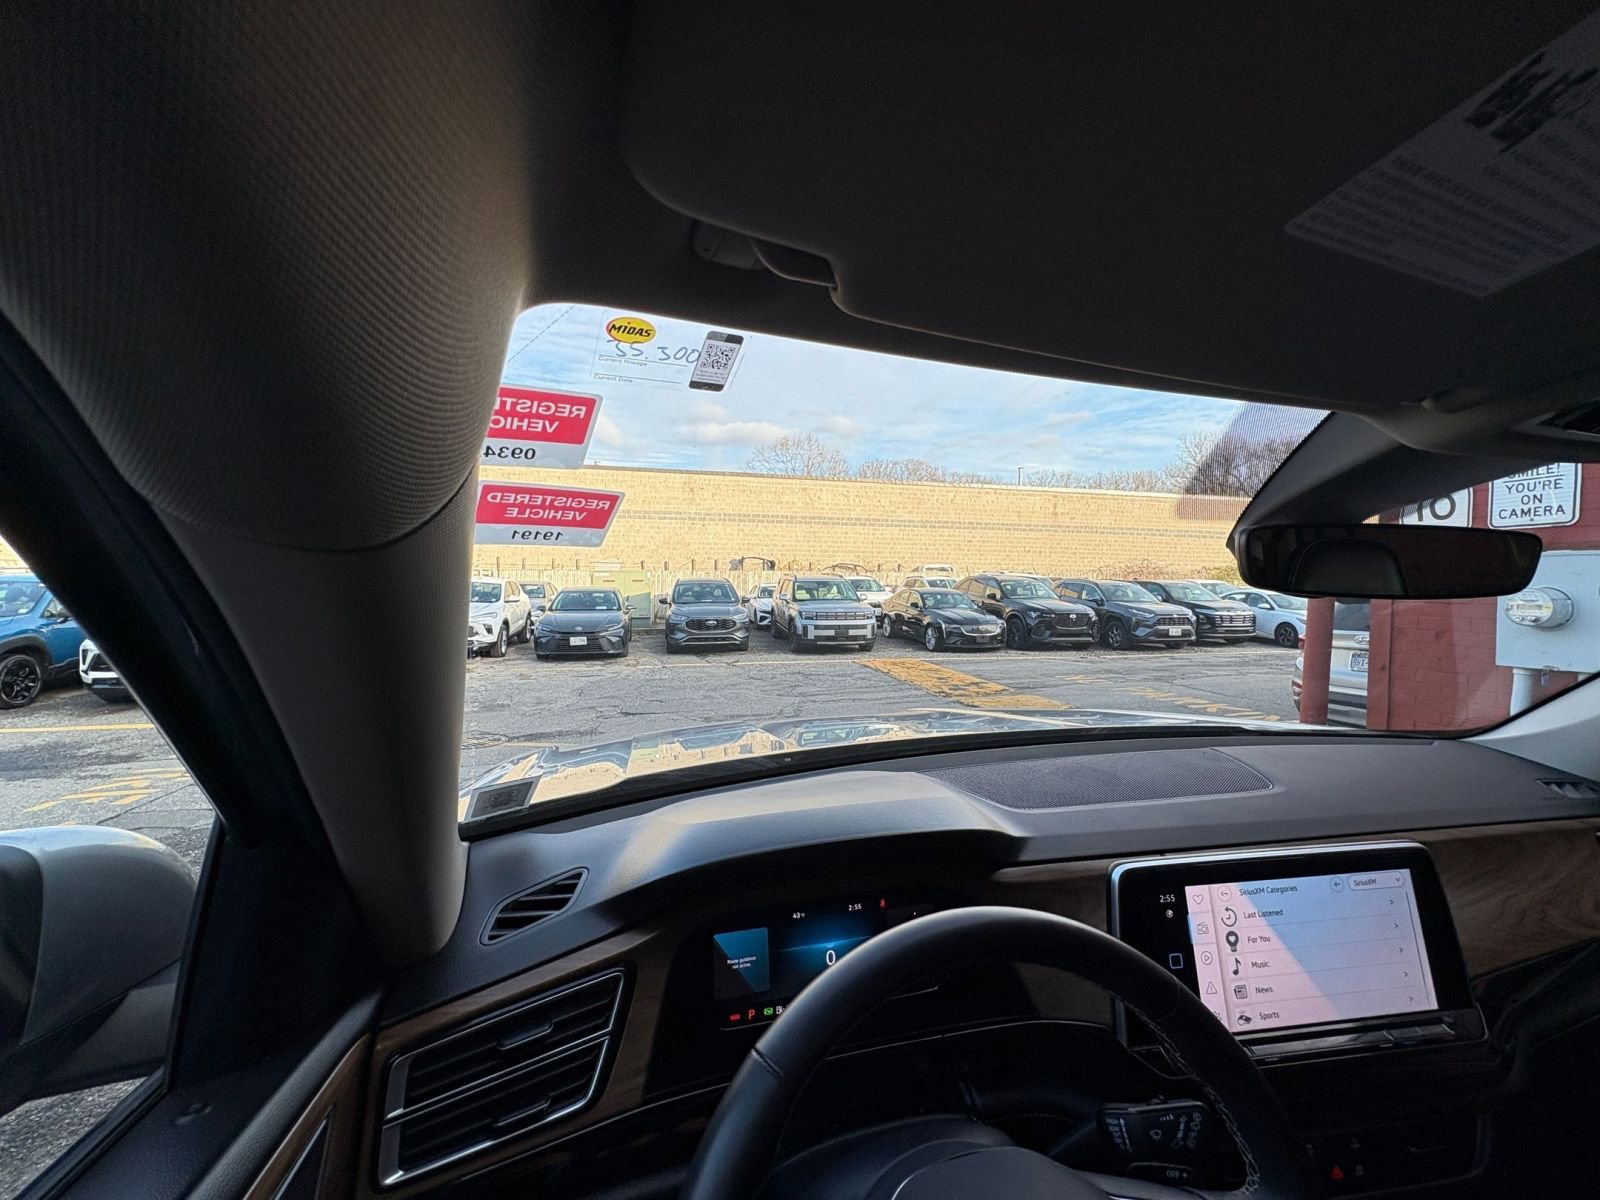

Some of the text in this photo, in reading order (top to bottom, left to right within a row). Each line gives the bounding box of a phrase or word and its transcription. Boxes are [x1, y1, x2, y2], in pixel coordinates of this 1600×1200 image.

[608, 321, 652, 338] MIDAS
[598, 356, 622, 364] Current
[593, 374, 618, 382] Current
[1505, 478, 1564, 494] YOU'RE
[1521, 493, 1543, 505] ON
[1498, 504, 1566, 520] CAMERA
[1353, 878, 1377, 887] SiriusXM
[1239, 885, 1298, 896] SiriusXM Categories
[1159, 894, 1176, 903] 2:55
[848, 903, 862, 911] 2:55
[1243, 909, 1284, 919] Last Listened
[1247, 935, 1271, 944] For You
[1251, 960, 1270, 969] Music
[1255, 986, 1273, 994] News
[1259, 1011, 1280, 1020] Sports
